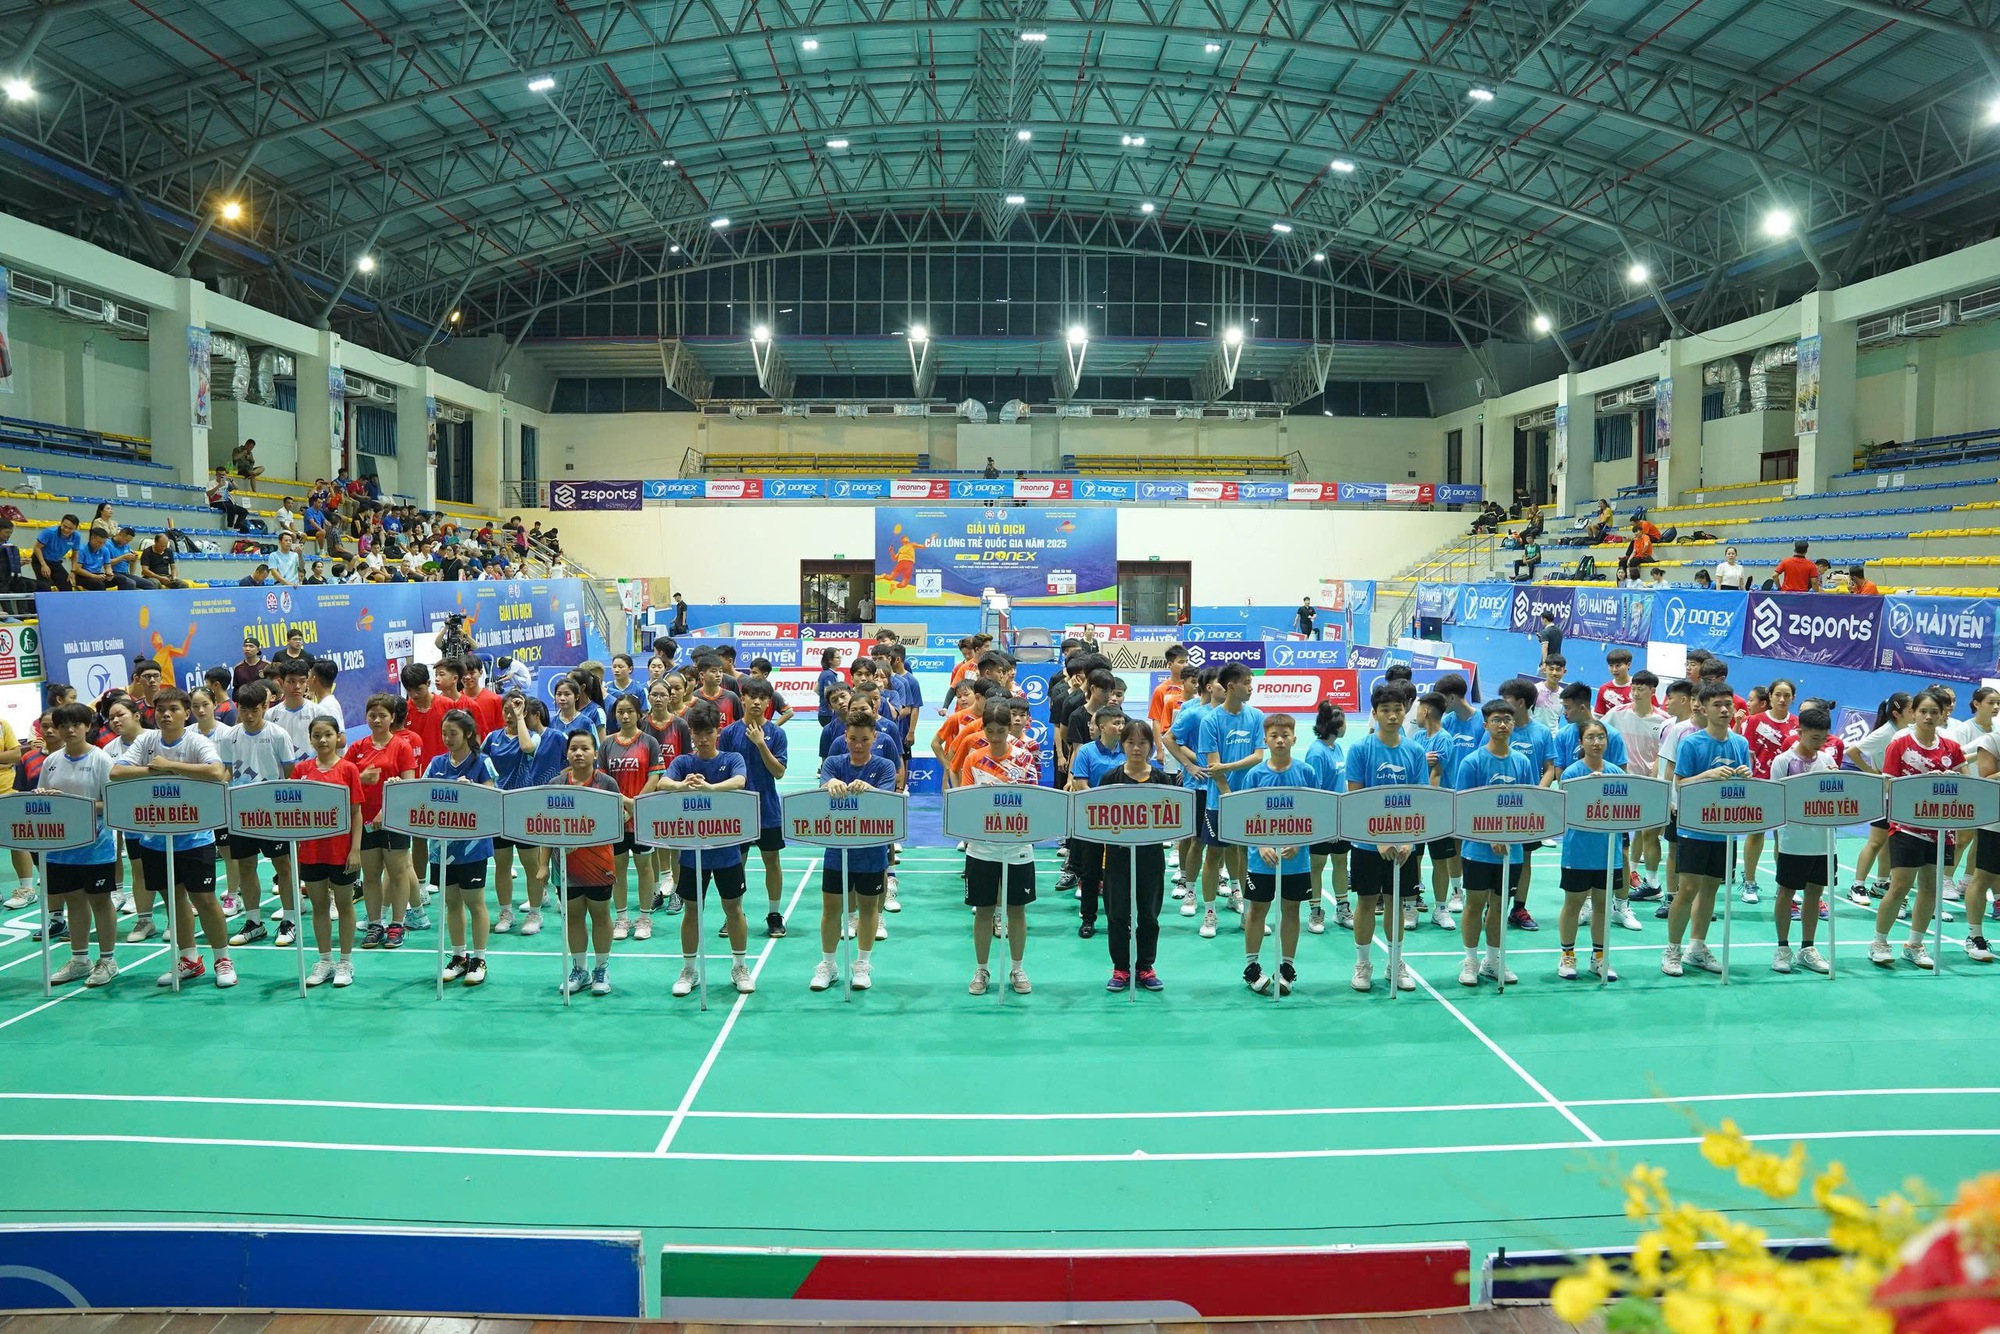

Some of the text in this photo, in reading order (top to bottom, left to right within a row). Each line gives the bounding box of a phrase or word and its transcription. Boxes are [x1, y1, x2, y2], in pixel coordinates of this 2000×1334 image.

[581, 489, 637, 502] zsports
[967, 521, 1025, 536] GIẢI VÔ ĐỊCH
[925, 536, 1067, 549] CẦU LÔNG TRẺ QUỐC GIA NĂM 2025
[982, 551, 1038, 561] DONEX
[1479, 597, 1506, 609] DONEX
[1688, 609, 1734, 627] DONEX
[272, 620, 288, 648] VÔ
[1709, 628, 1727, 639] Sport
[1789, 613, 1872, 644] zsports
[64, 638, 124, 655] NHÀ TÀI TRỢ CHÍNH
[344, 650, 364, 674] 2025
[1140, 656, 1171, 669] D-AVAN
[1210, 650, 1260, 664] zsports
[1357, 656, 1379, 669] zsports
[775, 681, 818, 691] PRONI
[1027, 681, 1043, 698] 2
[1257, 683, 1312, 693] PRONING
[608, 757, 639, 769] HYFA
[152, 784, 180, 799] ĐOÀN
[1603, 782, 1628, 796] ĐOÀN
[1721, 785, 1745, 799] ĐOÀN
[1820, 778, 1844, 792] ĐOÀN
[1932, 780, 1958, 796] ĐOÀN
[275, 787, 302, 803] ĐOÀN
[431, 788, 458, 803] ĐOÀN
[547, 794, 575, 809] ĐOÀN
[994, 792, 1022, 807] ĐOÀN
[1385, 794, 1412, 808] ĐOÀN
[1497, 793, 1523, 808] ĐOÀN
[25, 800, 51, 814] ĐOÀN
[683, 797, 711, 811] ĐOÀN
[1266, 796, 1294, 810] ĐOÀN
[1586, 800, 1641, 821] BẮC NINH
[1804, 798, 1859, 817] HƯNG YÊN
[1914, 798, 1974, 820] LÂM ĐỒNG
[134, 804, 200, 827] ĐIỆN BIÊN
[240, 806, 338, 828] THỪA THIÊN HUẾ
[409, 805, 476, 830] BẮC GIANG
[1086, 799, 1182, 836] TRỌNG TÀI
[1701, 803, 1764, 824] HẢI DƯƠNG
[12, 820, 65, 840] TRÀ VINH
[526, 813, 596, 835] ĐỒNG THÁP
[652, 817, 741, 839] TUYÊN QUANG
[794, 814, 894, 836] TP. HỒ CHÍ MINH
[984, 813, 1028, 836] HÀ NỘI
[1244, 815, 1312, 836] HẢI PHÒNG
[1367, 813, 1426, 837] QUÂN ĐỘI
[1472, 813, 1545, 836] NINH THUẬN
